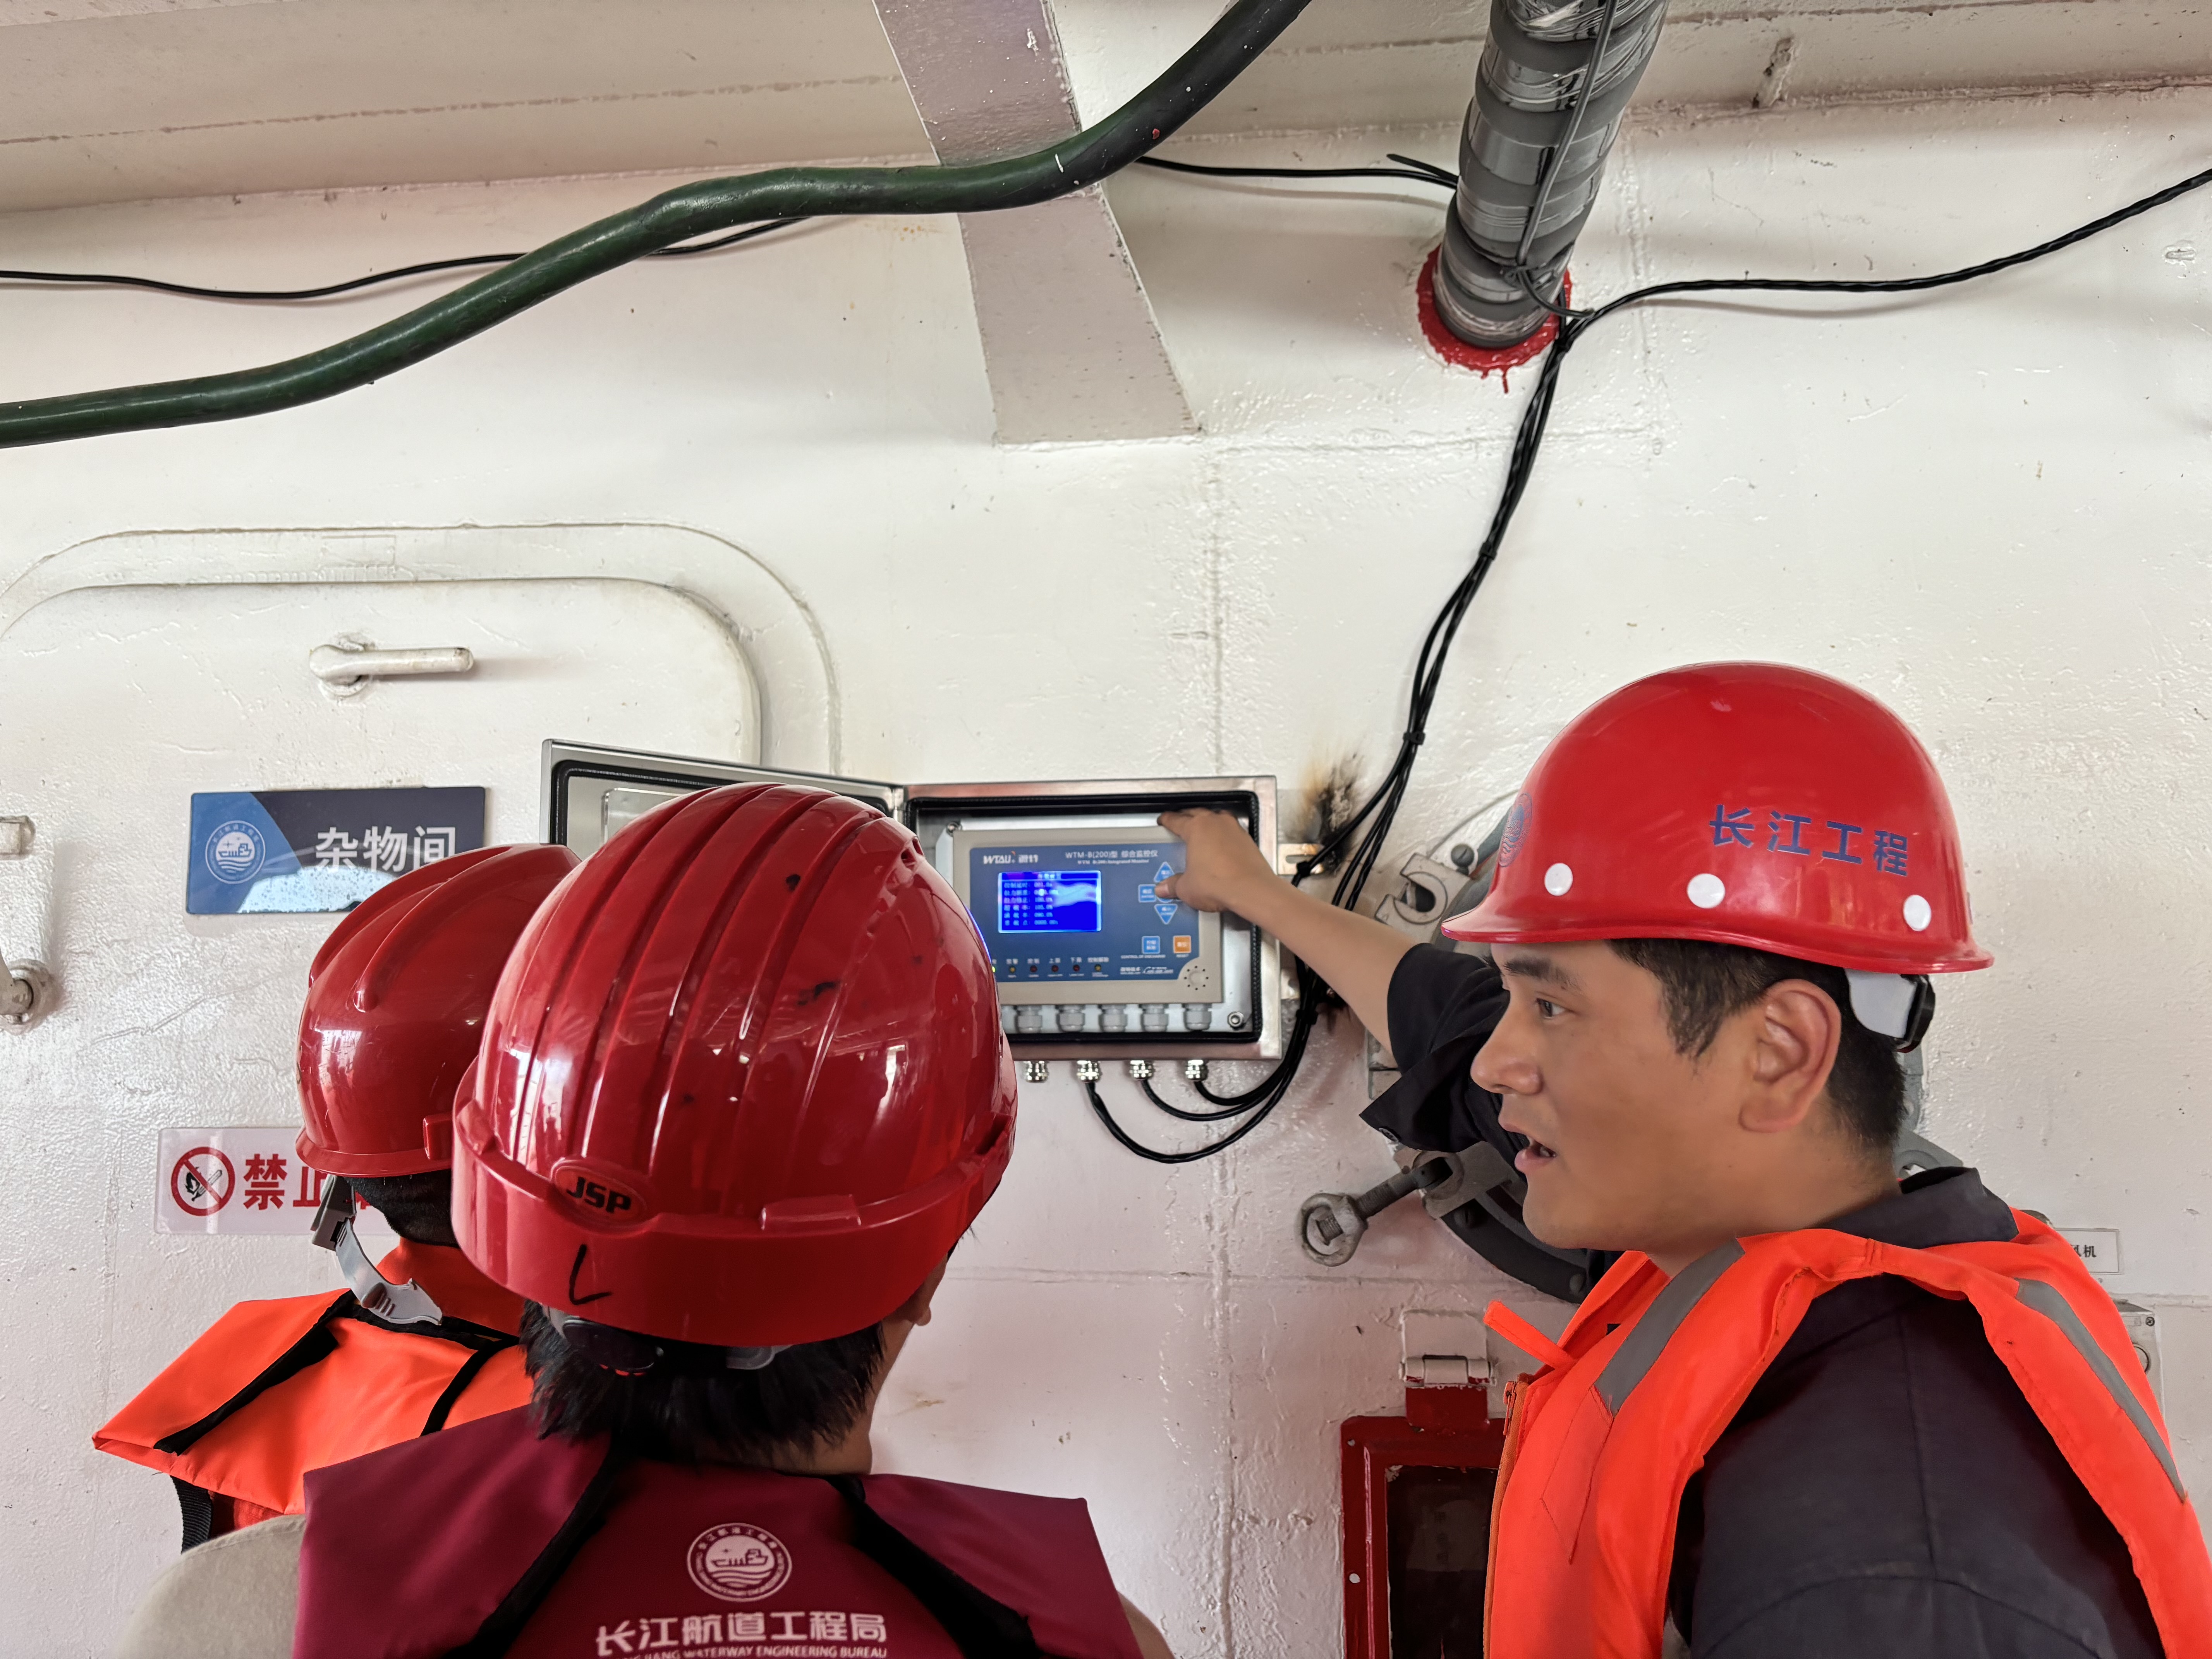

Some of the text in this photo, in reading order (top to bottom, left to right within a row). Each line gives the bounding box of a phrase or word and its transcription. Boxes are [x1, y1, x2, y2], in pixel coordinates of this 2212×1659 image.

[316, 826, 455, 872] 杂物间
[1709, 804, 1907, 877] 长江工程
[567, 1177, 631, 1214] JSP
[596, 1611, 887, 1657] 长江航道工程局
[683, 1645, 753, 1658] WATERWAY
[756, 1645, 838, 1658] ENGINEERING
[840, 1646, 887, 1658] BUREAU
